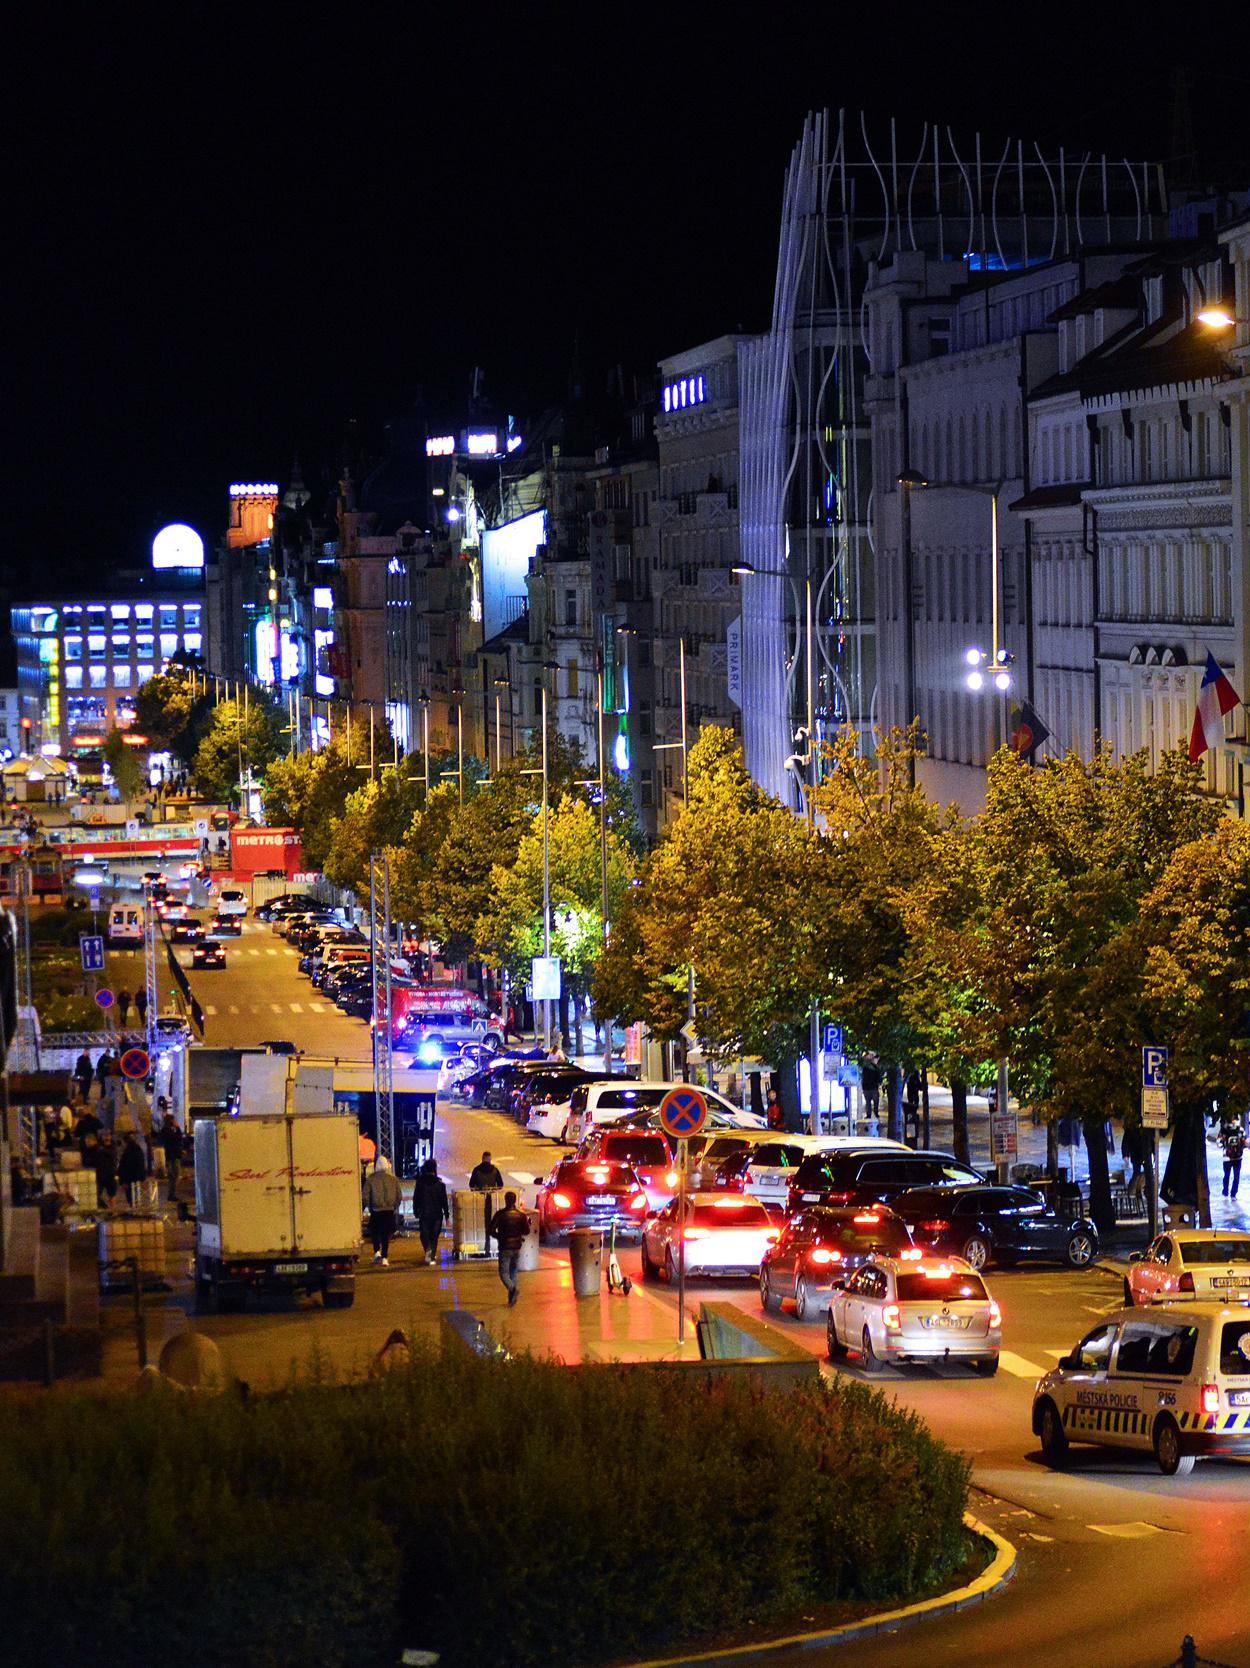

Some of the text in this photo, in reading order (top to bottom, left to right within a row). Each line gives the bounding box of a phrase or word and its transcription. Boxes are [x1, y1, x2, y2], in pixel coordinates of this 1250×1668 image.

[730, 633, 739, 690] PRIMARK
[1148, 1051, 1163, 1075] P
[1110, 1393, 1138, 1408] POLICIE
